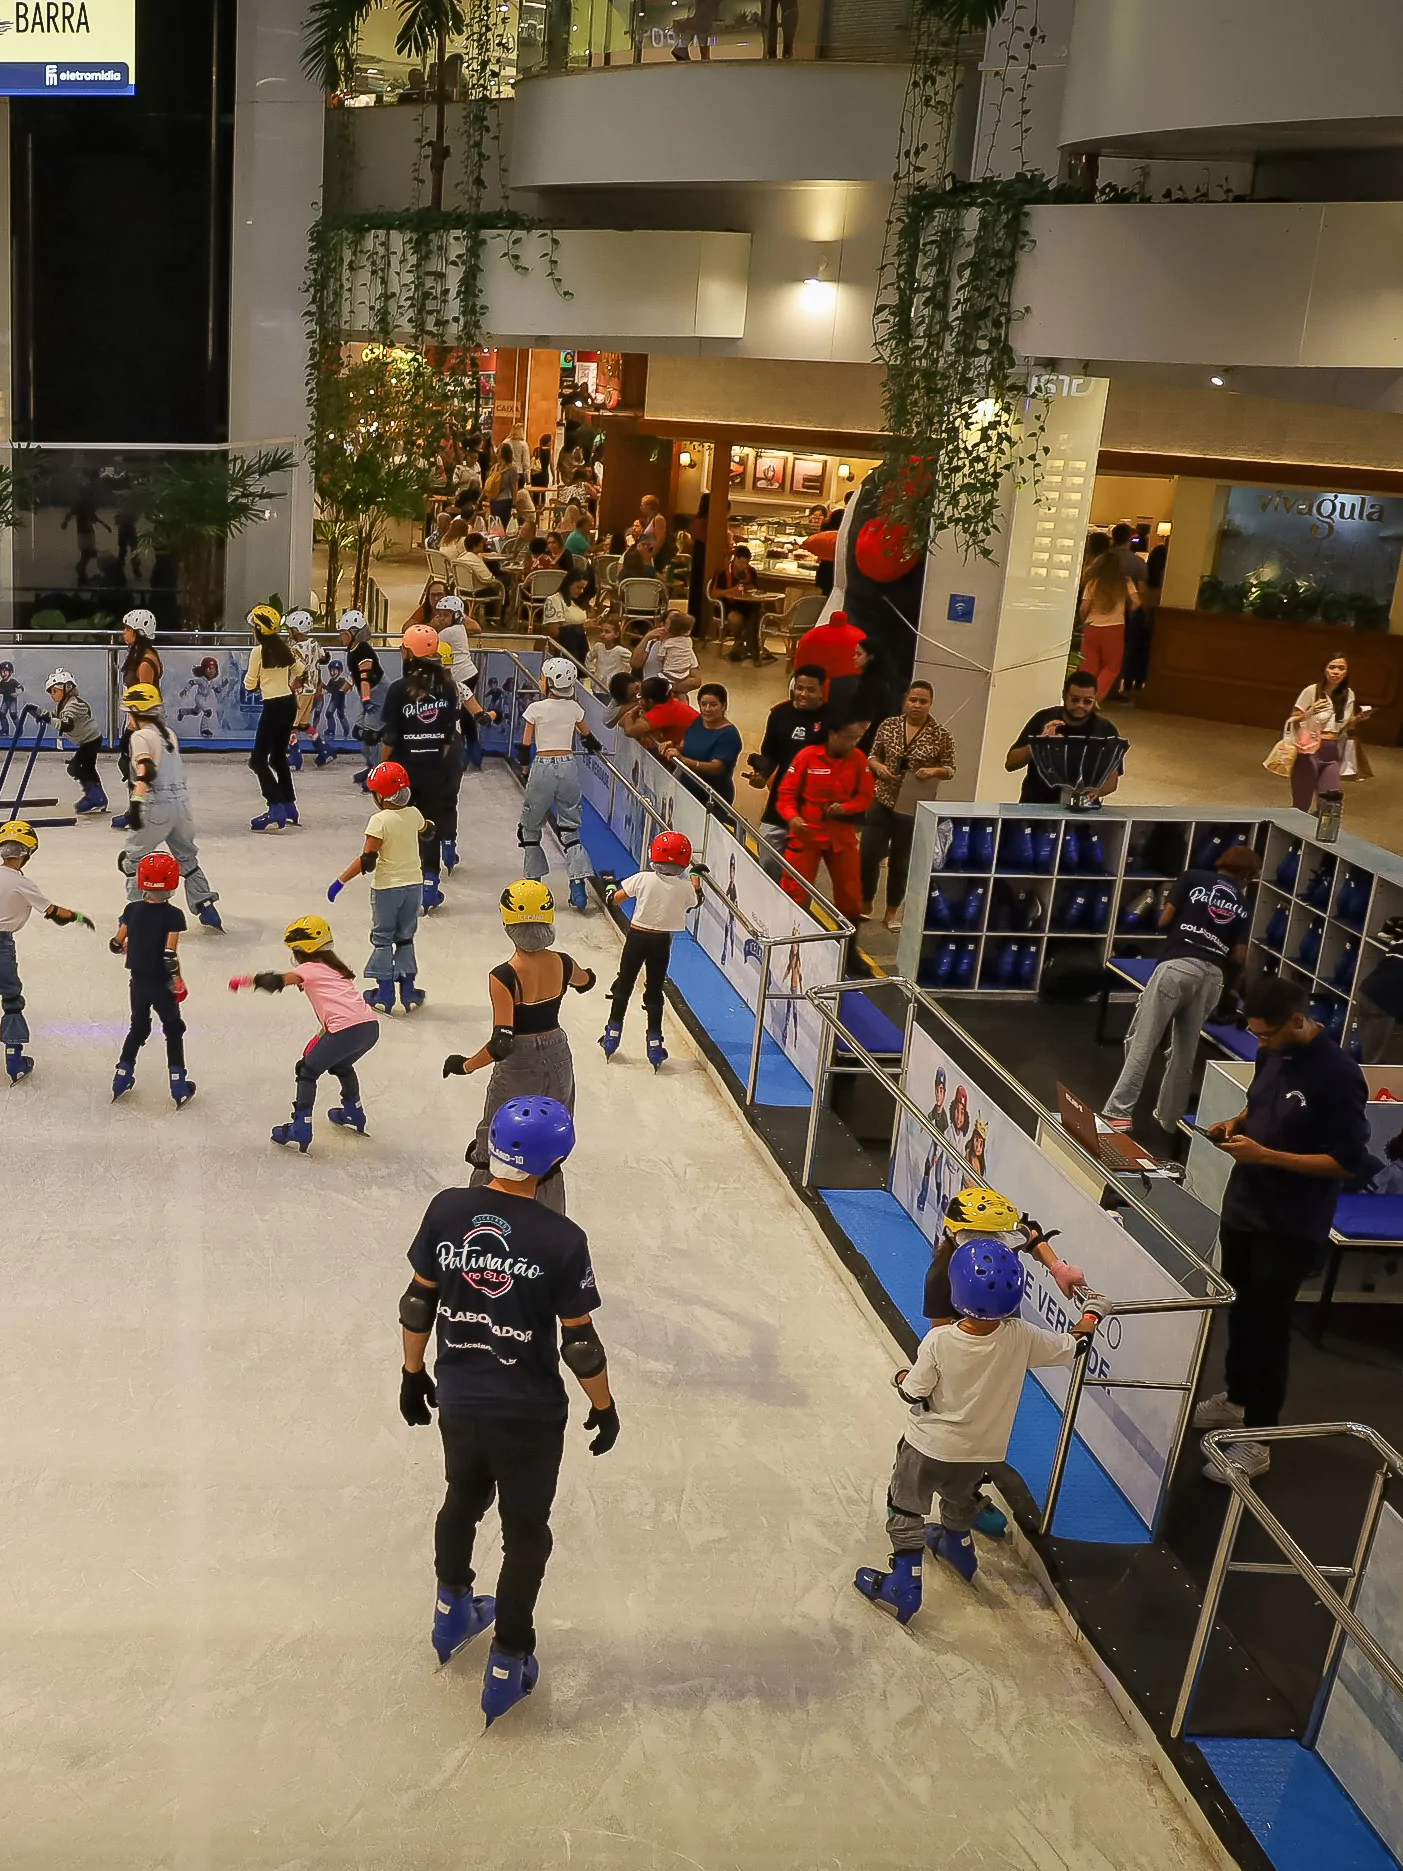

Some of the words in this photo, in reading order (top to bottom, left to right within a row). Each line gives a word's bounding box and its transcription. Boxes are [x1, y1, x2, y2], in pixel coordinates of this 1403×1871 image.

[16, 1, 90, 33] BARRA
[59, 69, 122, 81] eletromidia
[1257, 489, 1385, 539] vivagula
[436, 1241, 545, 1279] Patinação
[1037, 1283, 1111, 1396] VERDE.
